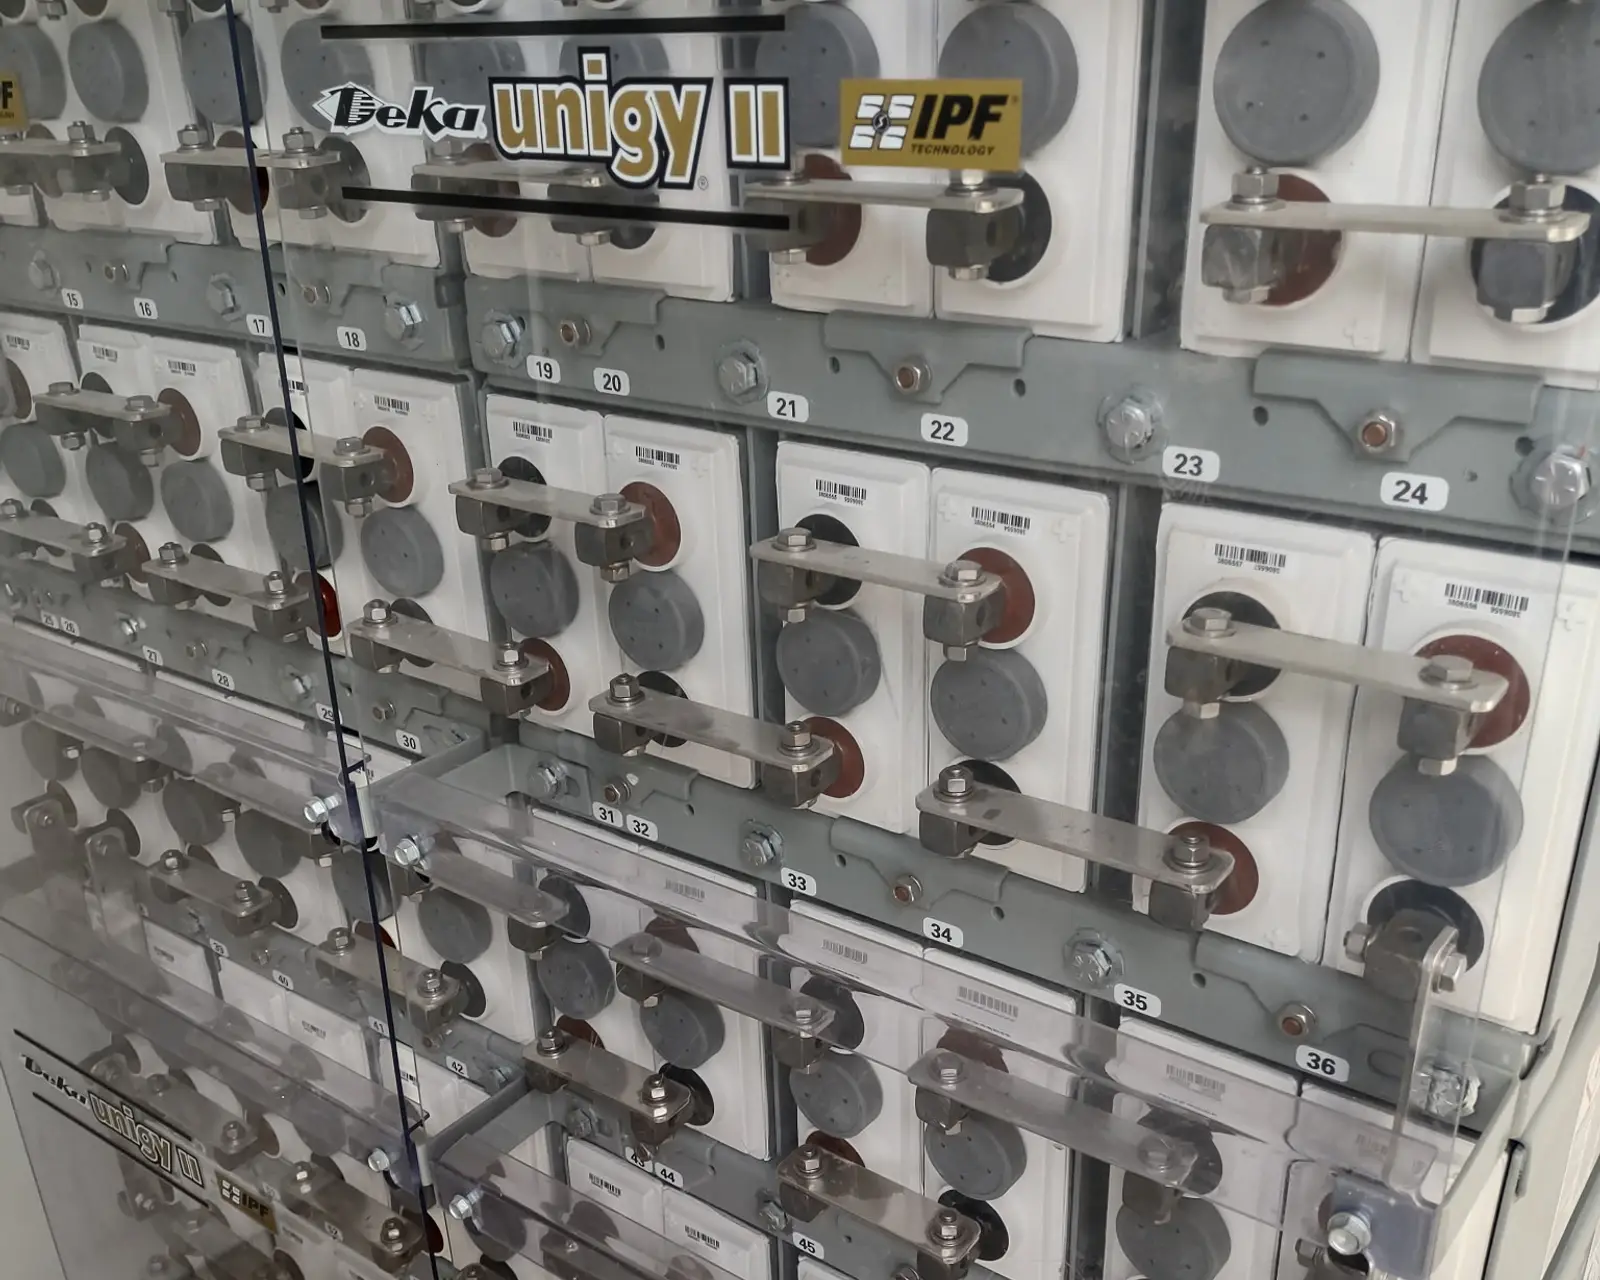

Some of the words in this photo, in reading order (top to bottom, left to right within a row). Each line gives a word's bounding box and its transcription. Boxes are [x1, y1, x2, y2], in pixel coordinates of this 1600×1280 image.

[314, 82, 486, 140] Deka
[488, 47, 714, 190] unigy
[913, 94, 1009, 141] IPF
[911, 143, 995, 156] TECHNOLOGY
[66, 292, 79, 303] 15
[139, 301, 152, 317] 16
[252, 318, 265, 334] 17
[344, 331, 360, 348] 18
[535, 361, 553, 379] 19
[602, 373, 622, 392] 20
[776, 397, 796, 418] 21
[930, 420, 955, 442] 22
[1173, 453, 1203, 477] 23
[1392, 479, 1428, 505] 24
[146, 649, 158, 663] 27
[216, 673, 229, 687] 28
[321, 707, 335, 722] 29
[402, 734, 417, 750] 30
[599, 807, 614, 823] 31
[633, 819, 650, 837] 32
[788, 873, 807, 891] 33
[931, 922, 952, 943] 34
[1123, 990, 1147, 1011] 35
[373, 1020, 385, 1034] 41
[451, 1061, 464, 1075] 42
[1306, 1051, 1336, 1075] 36
[88, 1090, 173, 1174] unigy
[660, 1168, 676, 1183] 44
[798, 1237, 816, 1254] 45
